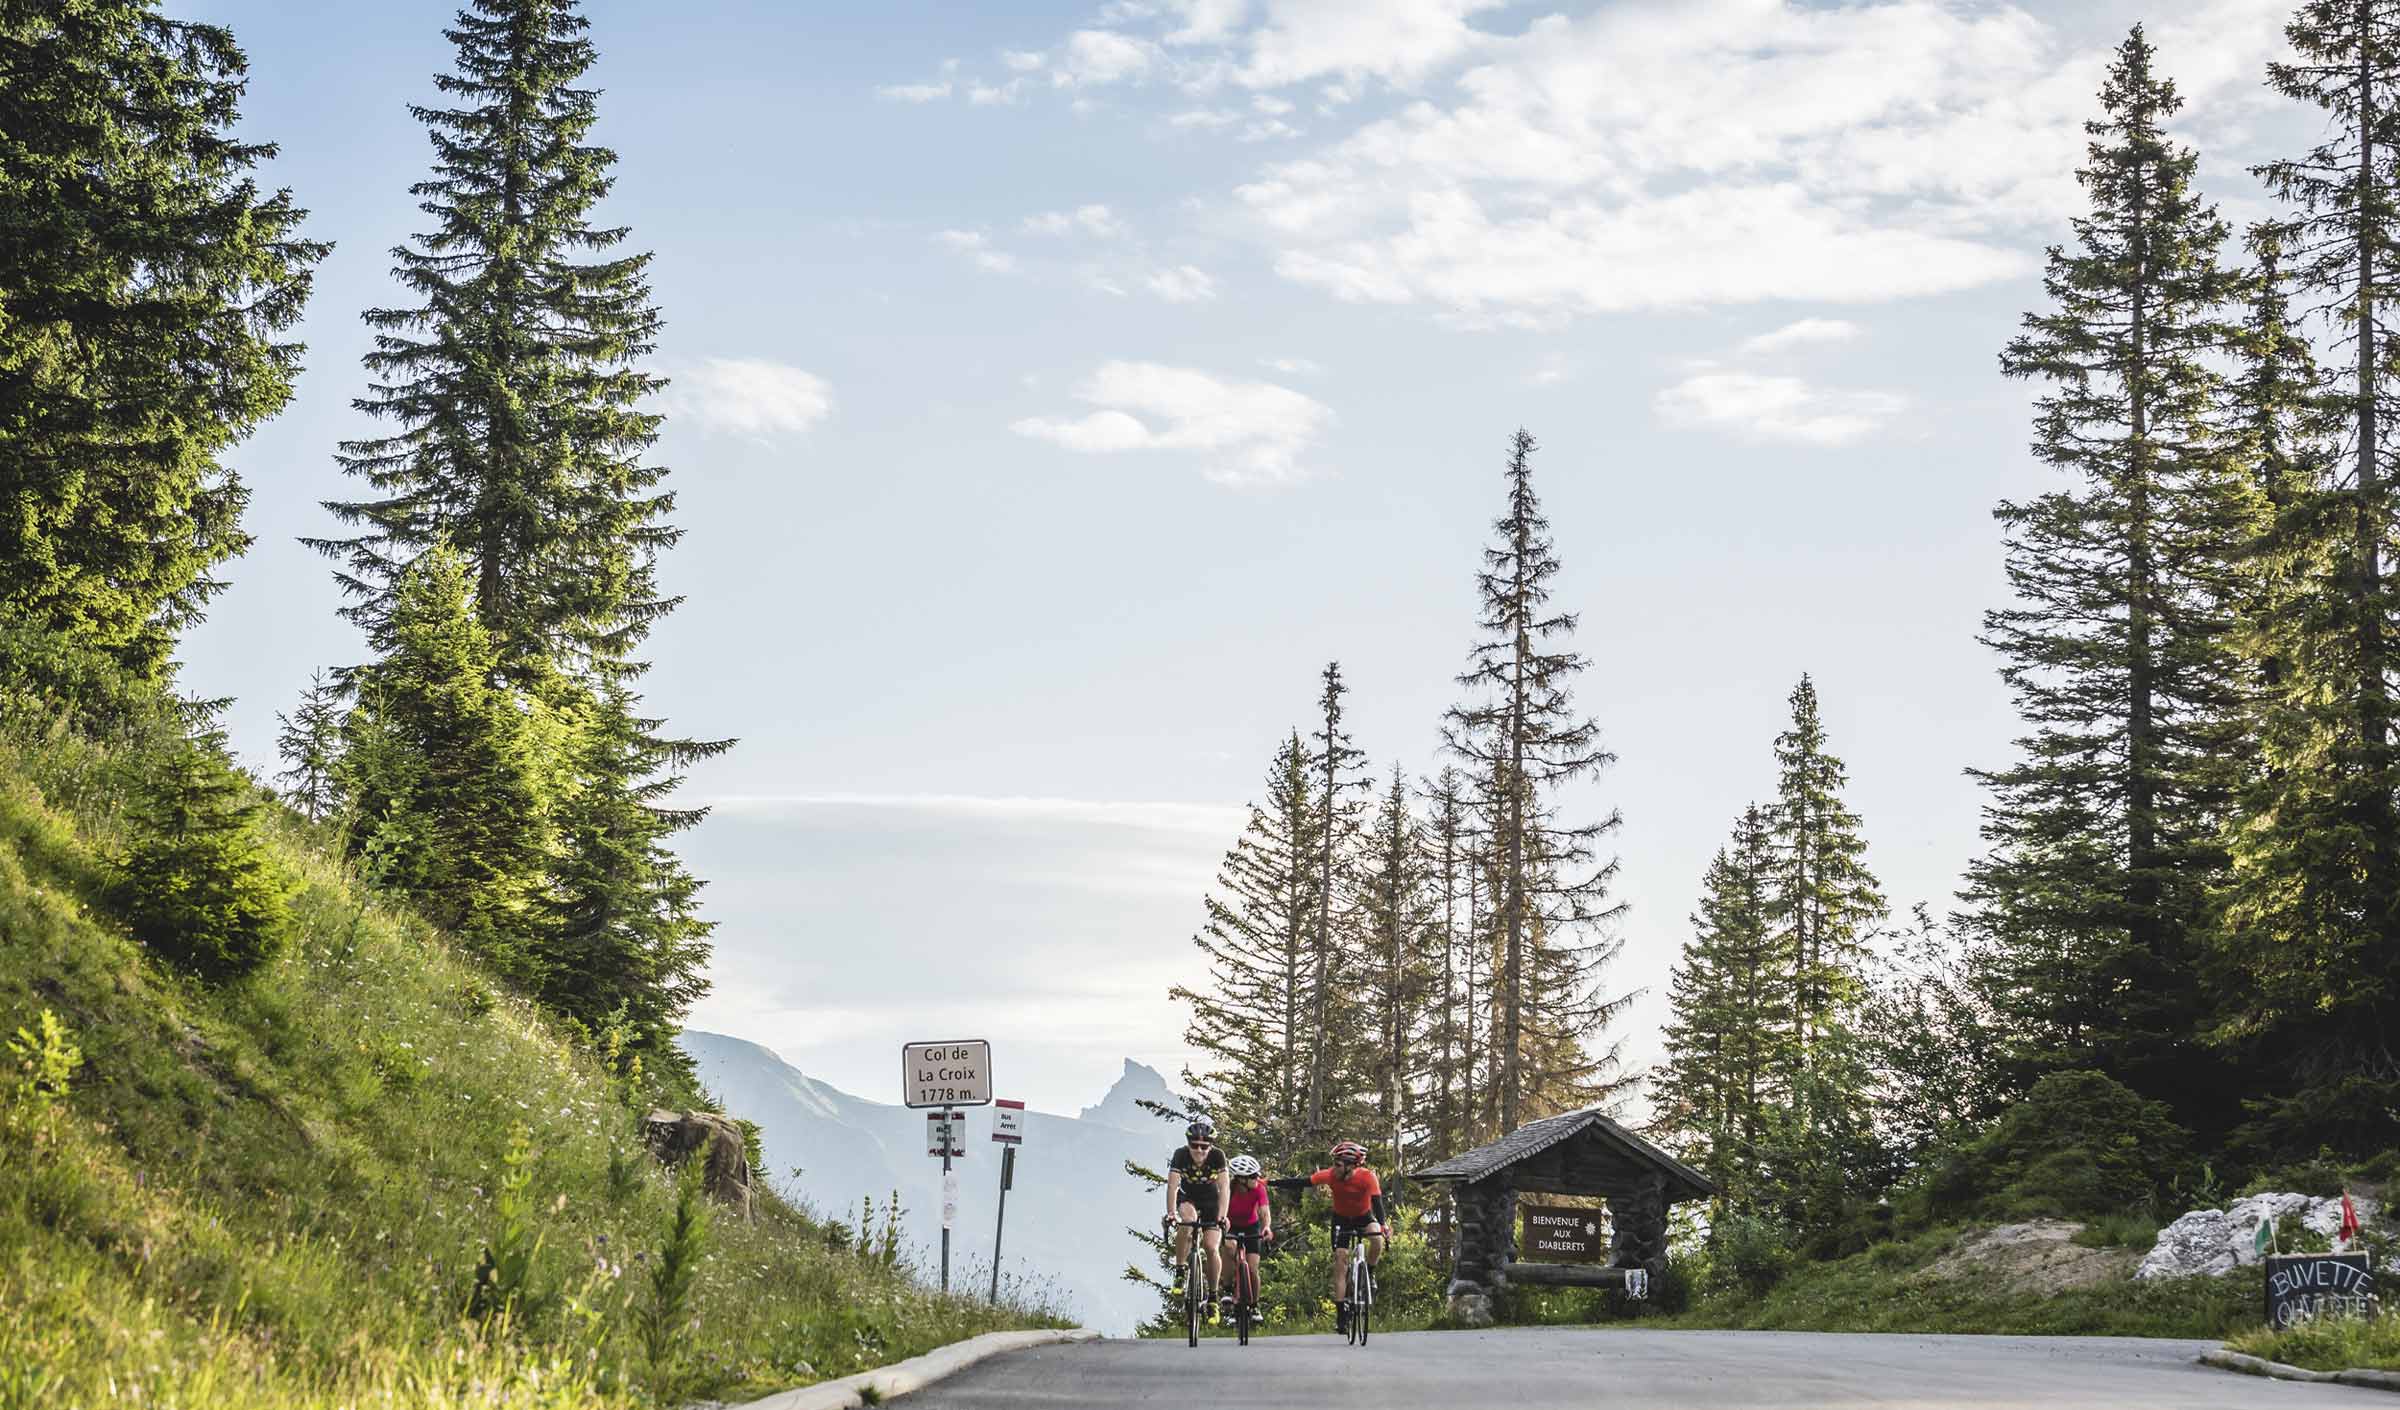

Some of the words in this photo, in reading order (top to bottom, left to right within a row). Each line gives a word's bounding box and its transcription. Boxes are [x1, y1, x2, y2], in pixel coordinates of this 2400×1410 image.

[924, 1047, 946, 1061] Col
[952, 1046, 969, 1060] de
[918, 1069, 934, 1082] La
[939, 1066, 976, 1081] Croix
[920, 1087, 955, 1102] 1778
[959, 1088, 976, 1100] m.
[1532, 1215, 1581, 1228] BIENVENUE
[1553, 1229, 1572, 1239] AUX
[1538, 1240, 1585, 1252] DIABLERETS
[2270, 1260, 2374, 1297] BUVETTE
